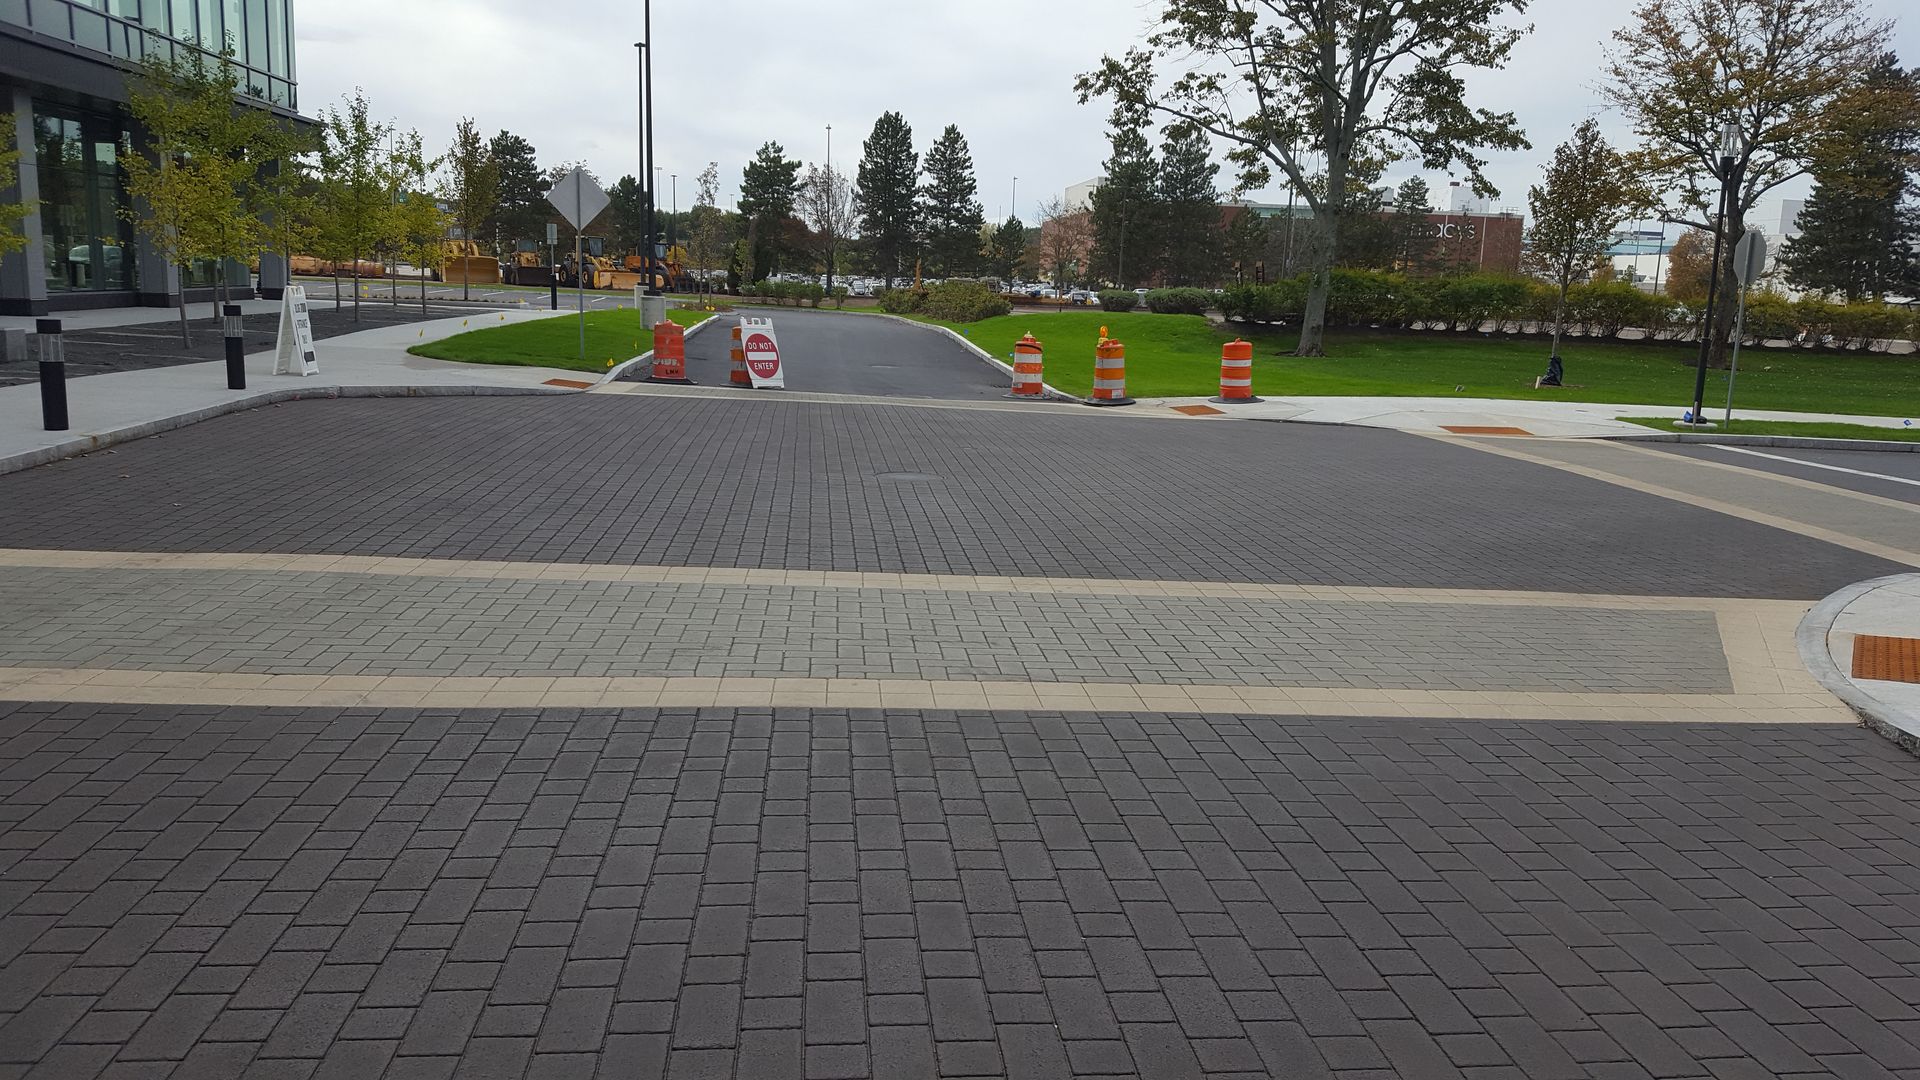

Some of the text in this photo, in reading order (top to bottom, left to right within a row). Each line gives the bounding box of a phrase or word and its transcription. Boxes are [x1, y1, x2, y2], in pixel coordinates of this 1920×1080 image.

[747, 342, 772, 350] DO NOT
[754, 362, 774, 370] ENTER
